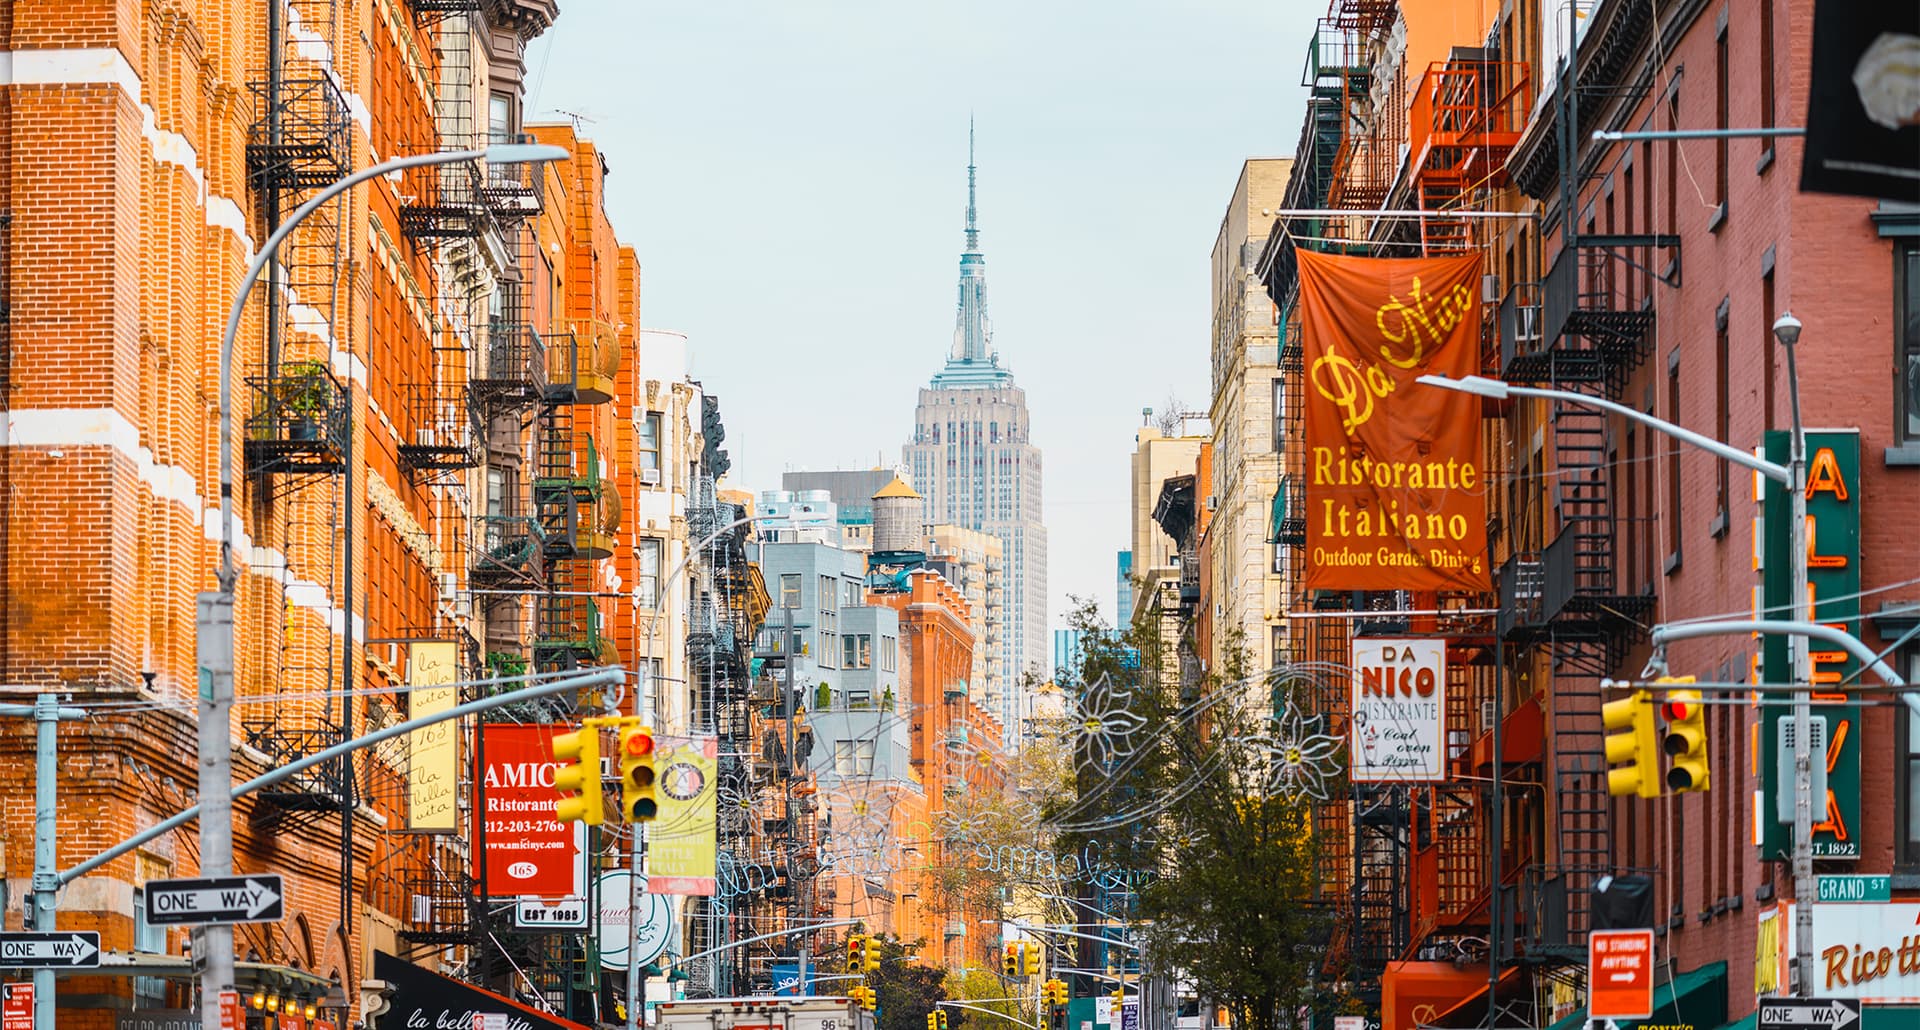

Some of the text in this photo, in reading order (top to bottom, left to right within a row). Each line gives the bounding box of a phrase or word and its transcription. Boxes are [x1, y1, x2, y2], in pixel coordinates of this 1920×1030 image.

[1311, 276, 1472, 436] Da Nico
[1313, 446, 1476, 489] Ristorante
[1322, 499, 1467, 541] Italiano
[1313, 546, 1481, 574] Outdoor Garden Dining
[418, 652, 440, 672] la
[1382, 646, 1416, 663] DA
[1361, 666, 1435, 698] NICO
[416, 691, 450, 708] vita
[1359, 702, 1438, 721] RISTORANTE
[419, 722, 447, 746] 163
[1383, 727, 1418, 741] Coal
[1396, 743, 1433, 753] oven
[1382, 753, 1419, 767] Pizza
[418, 766, 441, 785] la
[484, 762, 569, 788] AMIC
[413, 784, 451, 807] bella
[487, 797, 559, 812] Ristorante
[416, 803, 451, 821] vita
[485, 820, 565, 833] 212-203-2766
[1828, 843, 1856, 855] 1892
[512, 865, 533, 875] 165
[1820, 879, 1886, 899] GRAND ST
[158, 889, 264, 911] ONE WAY
[524, 909, 579, 921] EST 1985
[5, 943, 85, 956] ONE WAY
[1600, 955, 1641, 969] ANYTIME
[407, 1008, 430, 1029] la
[436, 1009, 480, 1030] bell
[504, 1016, 534, 1030] ita
[821, 1019, 836, 1030] 96
[1763, 1008, 1846, 1023] ONE WAY
